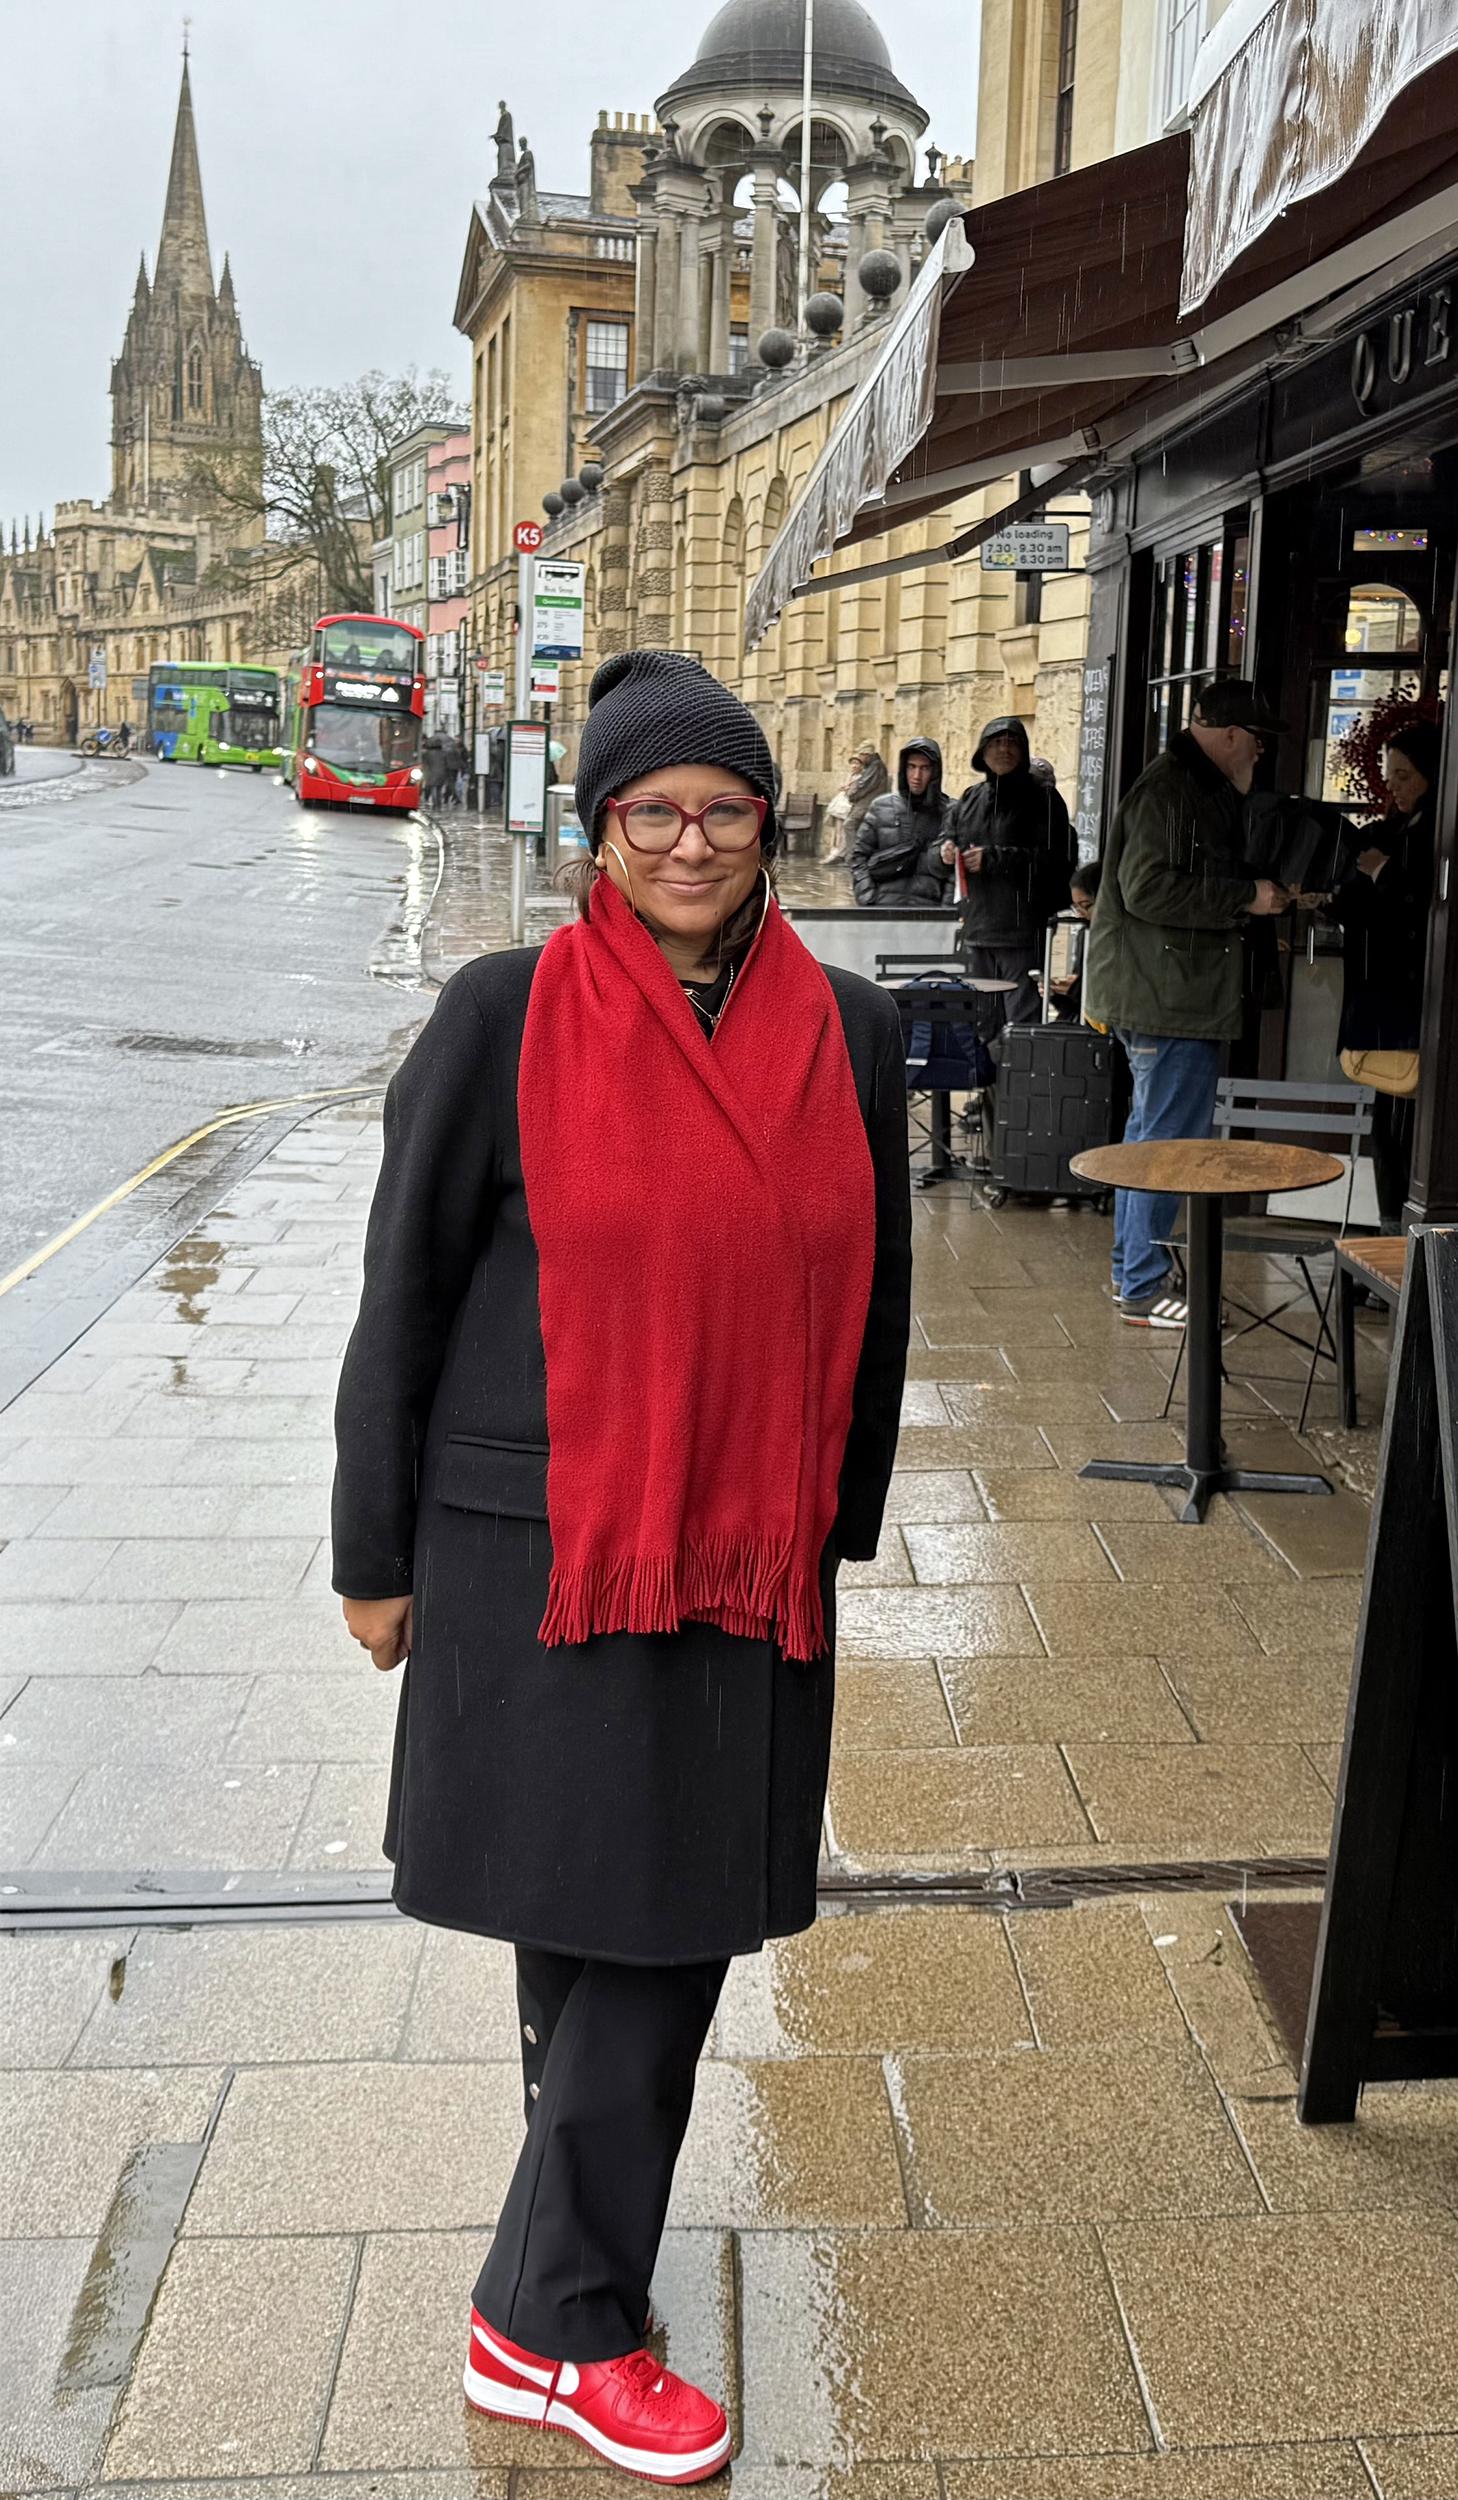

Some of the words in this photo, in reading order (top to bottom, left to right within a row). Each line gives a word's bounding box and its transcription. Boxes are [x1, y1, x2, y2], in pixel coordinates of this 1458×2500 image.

[517, 528, 540, 545] K5
[996, 529, 1012, 540] No
[1014, 529, 1054, 541] loading
[987, 544, 1011, 553] 7.30
[1019, 544, 1044, 553] 9.30
[1046, 545, 1063, 553] am
[1020, 555, 1045, 564] 6.30
[1047, 556, 1064, 566] pm
